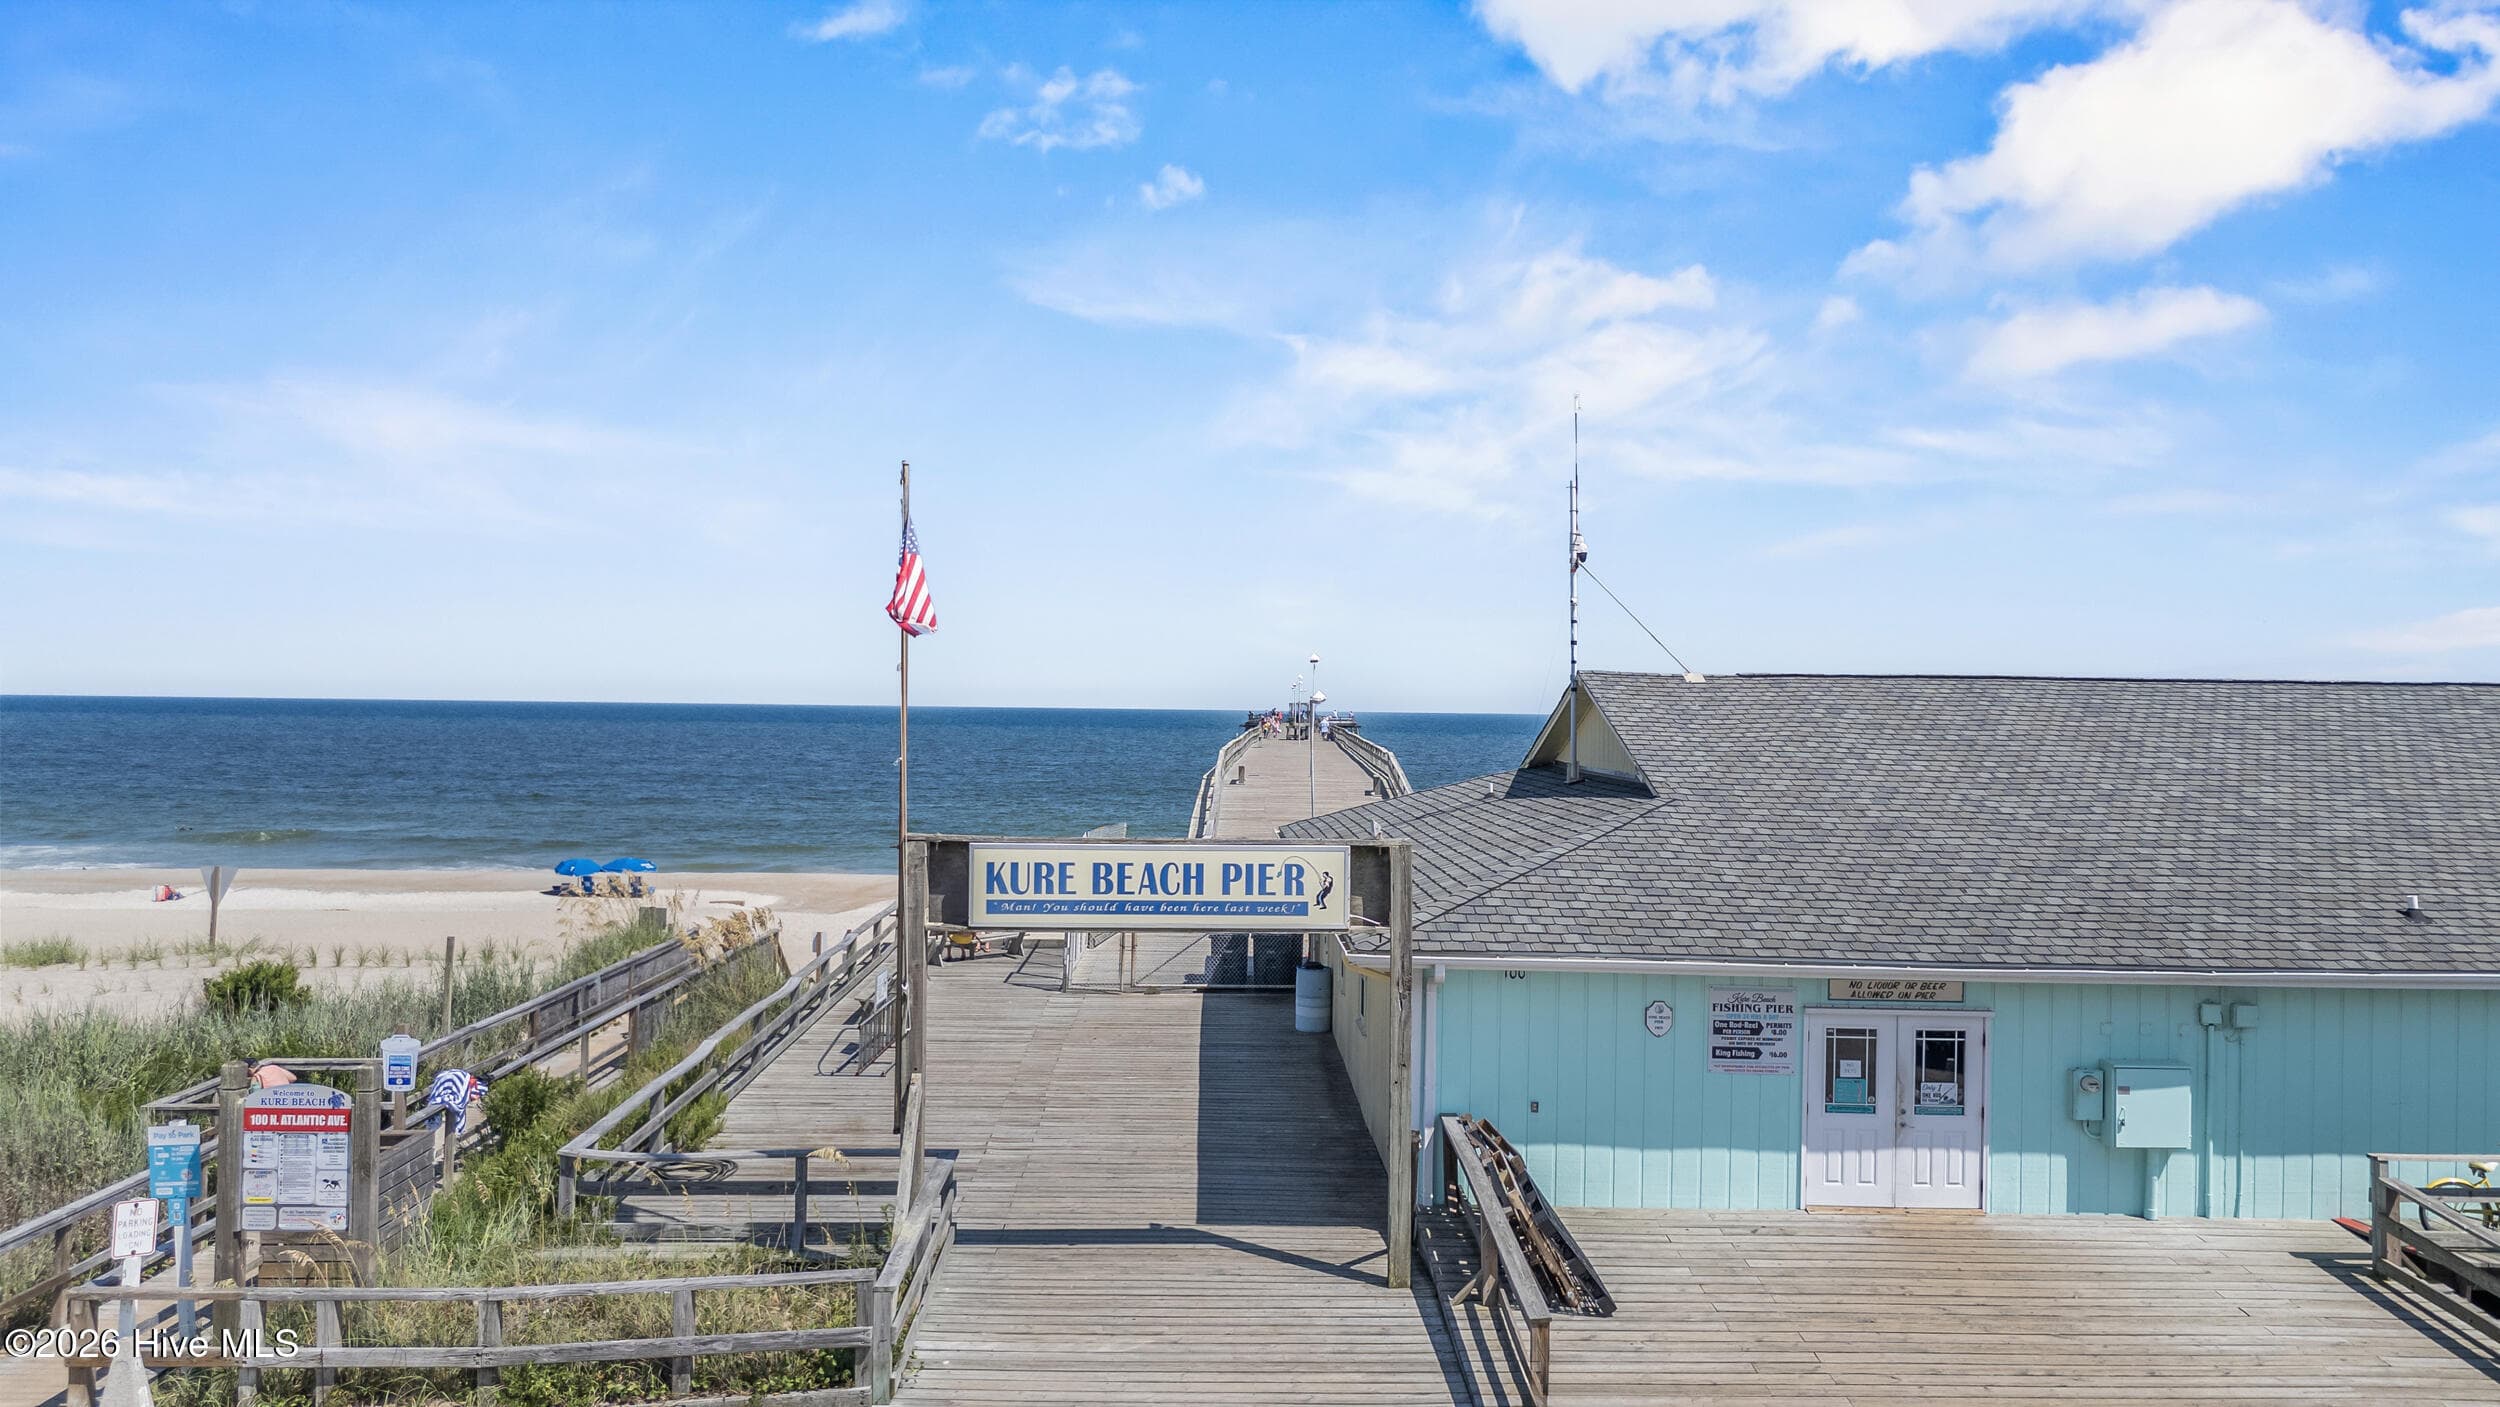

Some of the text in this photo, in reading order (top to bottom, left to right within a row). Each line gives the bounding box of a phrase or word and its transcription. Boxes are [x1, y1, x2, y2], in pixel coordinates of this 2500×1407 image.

[986, 861, 1305, 896] KURE BEACH PIER
[1042, 903, 1070, 914] You
[1073, 902, 1117, 914] should
[1124, 903, 1154, 914] have
[1160, 902, 1188, 914] been
[1193, 902, 1219, 914] here
[1225, 902, 1250, 914] last
[1849, 980, 1947, 991] NO LIQUOR OR BEER
[1850, 990, 1937, 1000] ALLOWED ON PIER
[1712, 1003, 1794, 1014] FISHING PIER
[1715, 1049, 1755, 1058] King Fishing
[261, 1097, 326, 1106] KURE BEACH
[250, 1114, 268, 1126] 100
[281, 1115, 326, 1126] ATLANTIC
[327, 1115, 348, 1126] AVE.
[118, 1217, 153, 1229] PARKING
